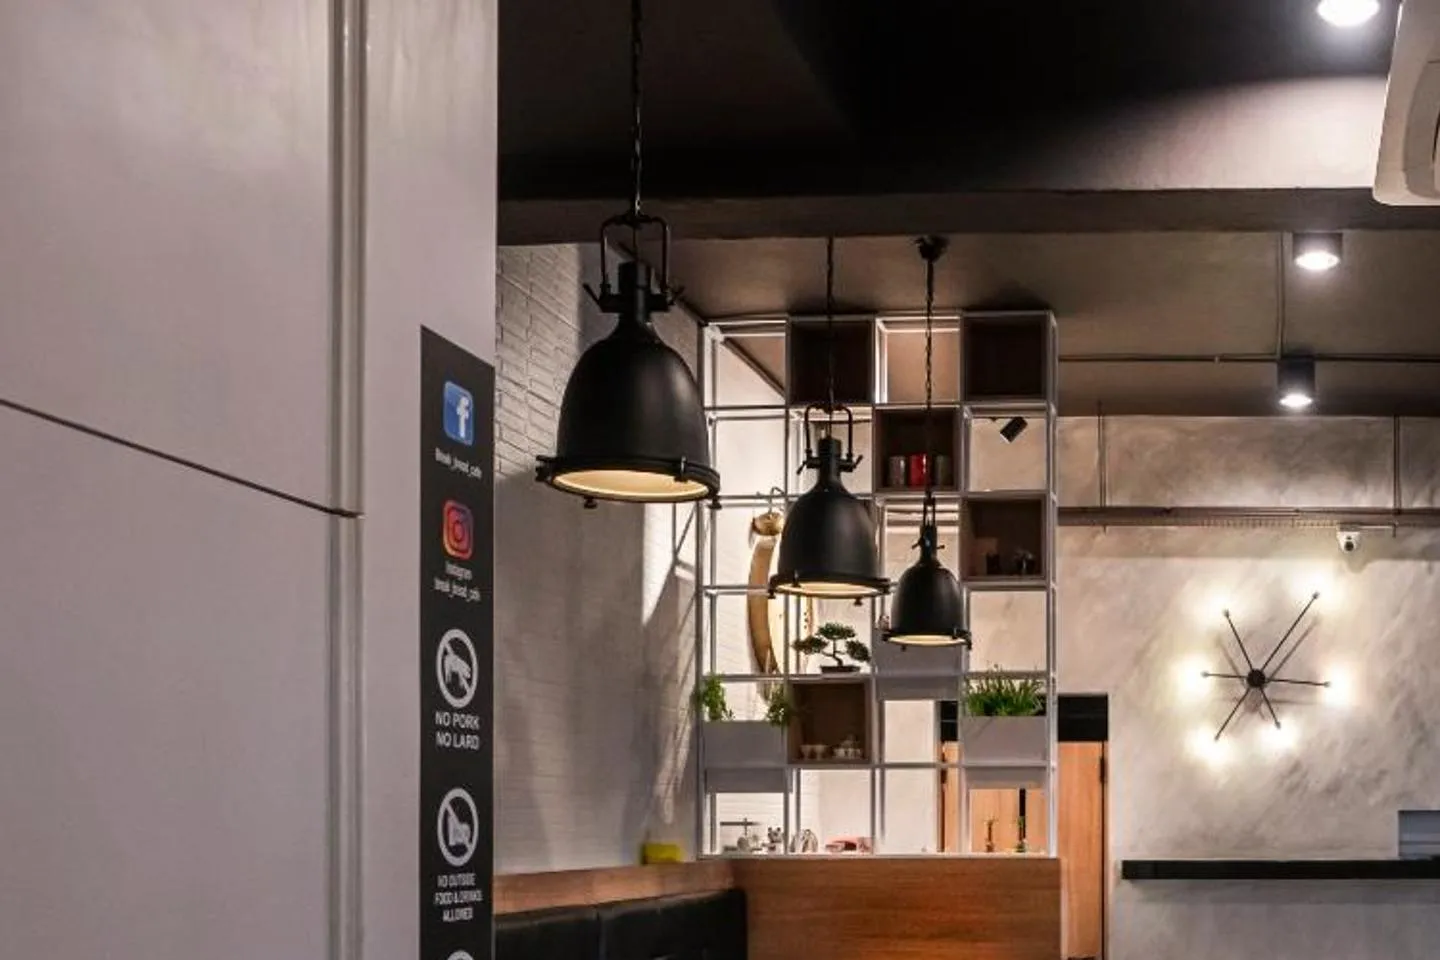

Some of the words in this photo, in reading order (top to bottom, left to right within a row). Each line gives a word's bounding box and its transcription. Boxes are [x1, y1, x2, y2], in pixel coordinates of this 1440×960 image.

[435, 711, 451, 727] NO
[452, 712, 480, 730] PORK
[436, 731, 451, 748] NO
[453, 733, 480, 751] LARD
